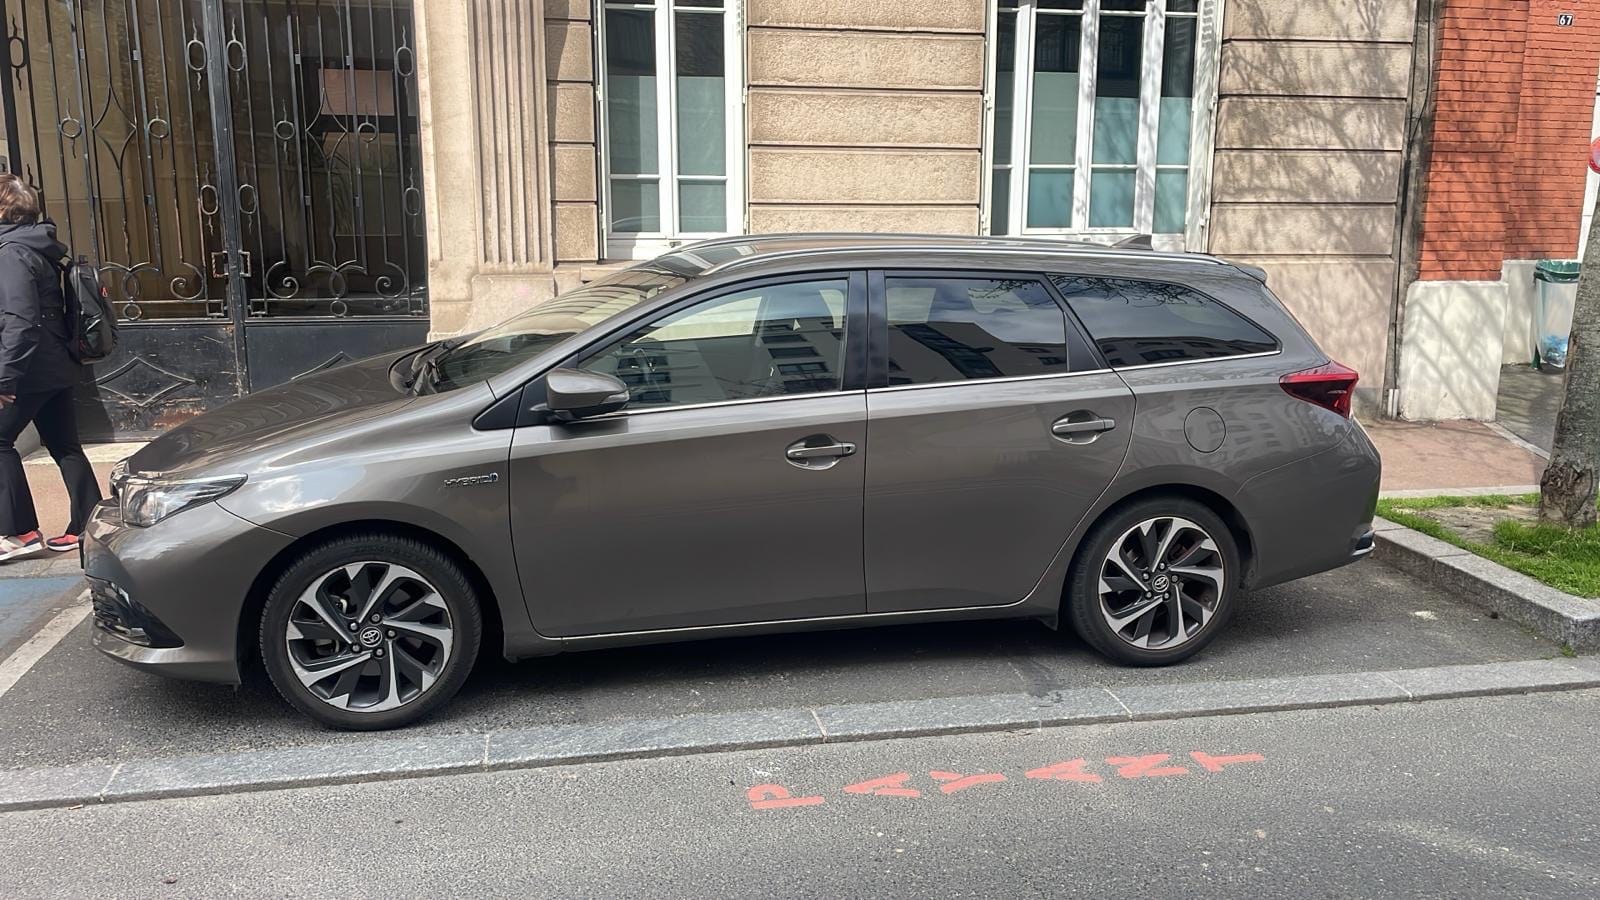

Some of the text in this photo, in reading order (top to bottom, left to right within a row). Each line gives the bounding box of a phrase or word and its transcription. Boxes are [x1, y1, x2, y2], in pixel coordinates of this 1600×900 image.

[1559, 15, 1573, 26] 67
[443, 474, 493, 487] HYBRID
[746, 751, 1265, 810] PAYANT
